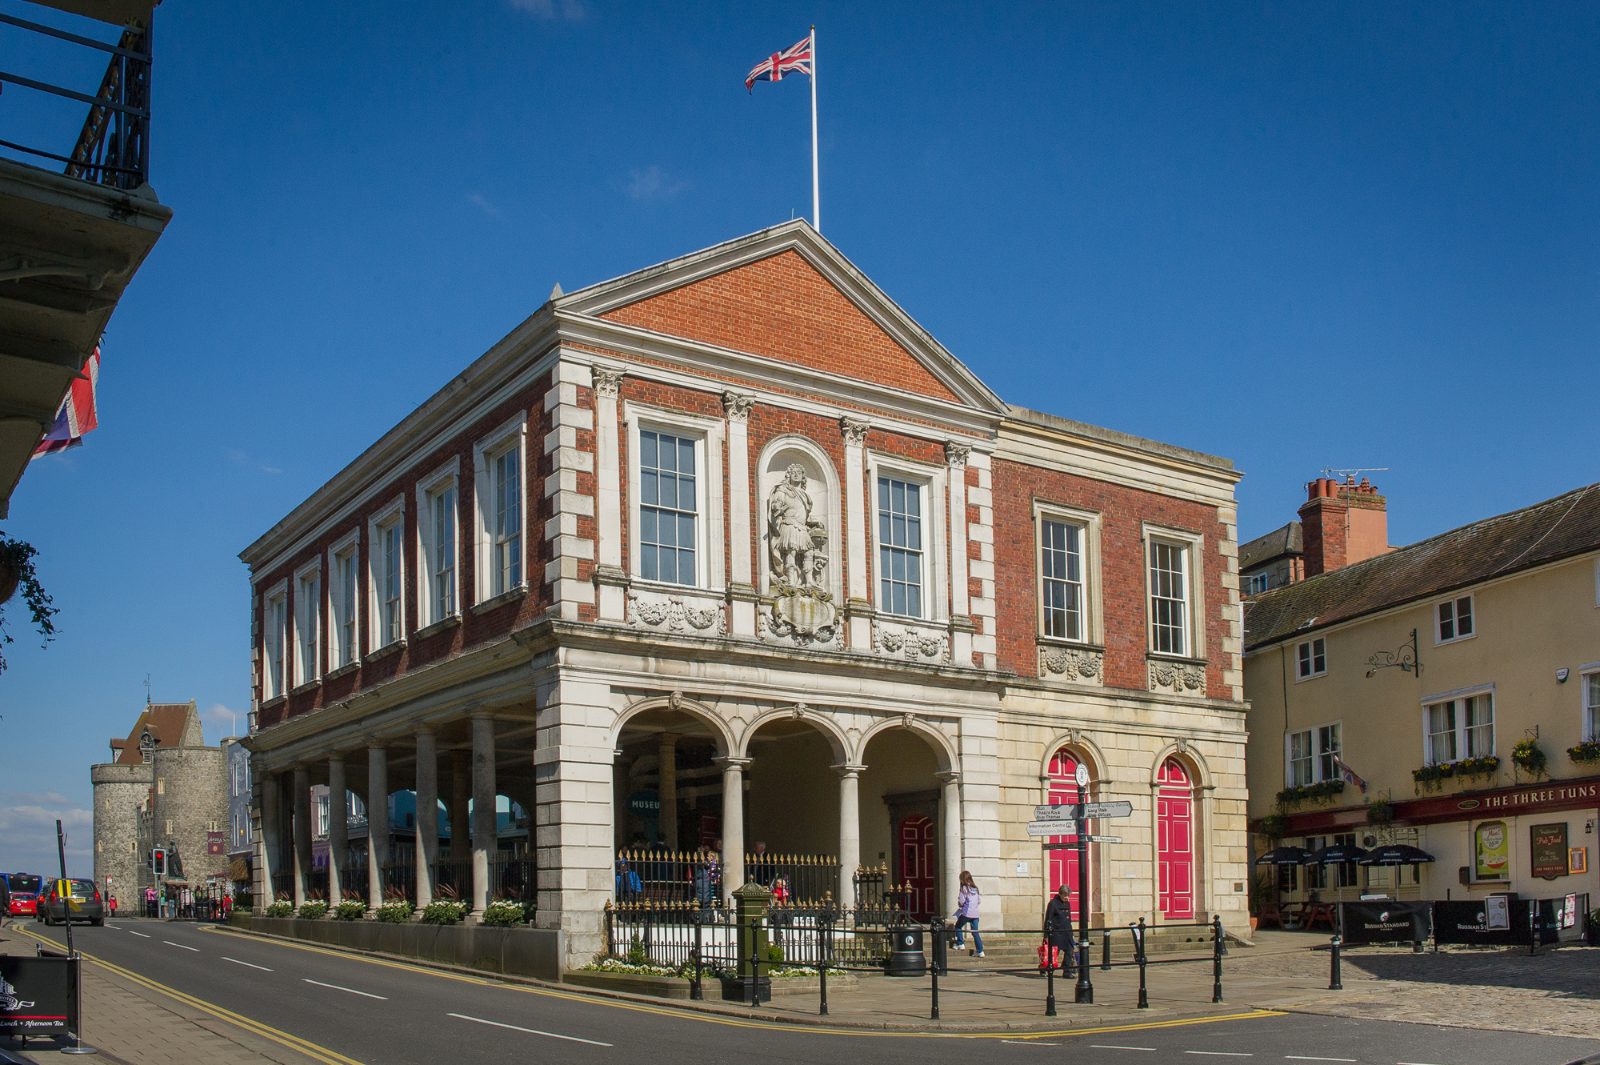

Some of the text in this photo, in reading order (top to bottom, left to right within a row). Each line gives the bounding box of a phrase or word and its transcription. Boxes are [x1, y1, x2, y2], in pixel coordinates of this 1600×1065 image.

[1485, 796, 1508, 807] THE
[1513, 790, 1555, 804] THREE
[1560, 785, 1597, 799] TUNS
[632, 800, 660, 809] MUSEU
